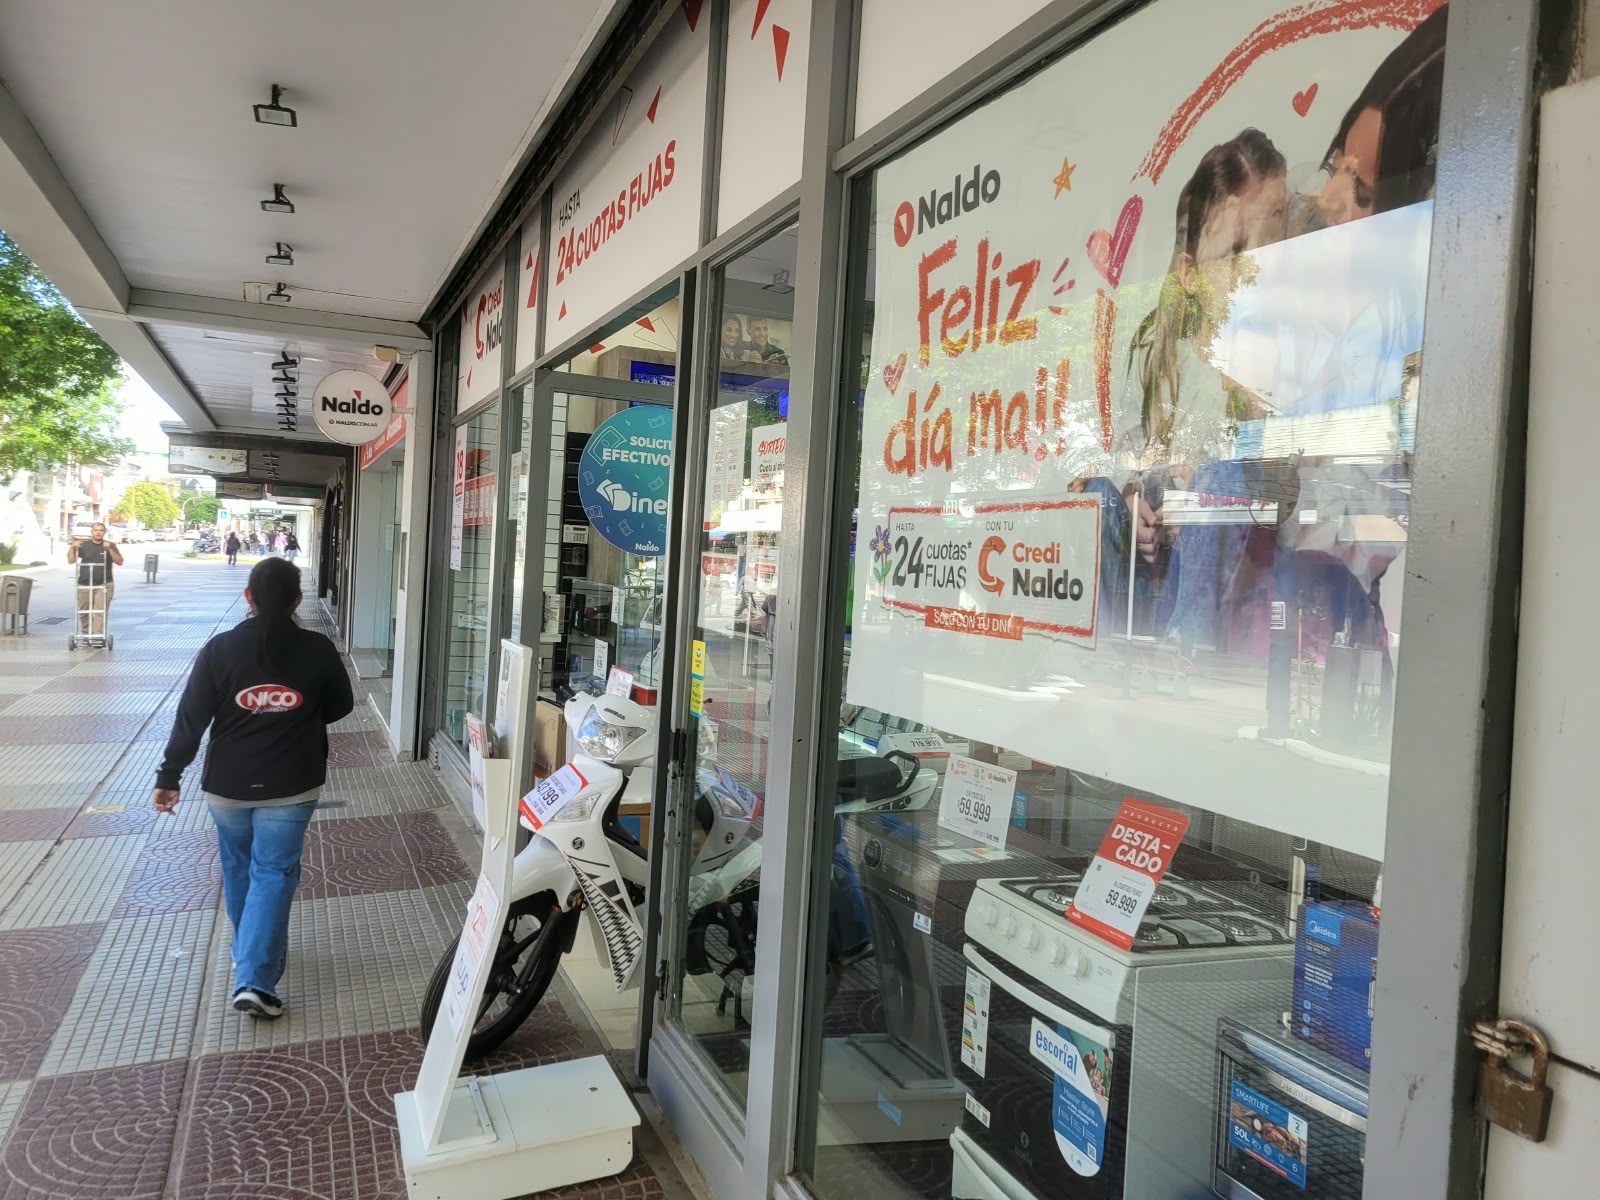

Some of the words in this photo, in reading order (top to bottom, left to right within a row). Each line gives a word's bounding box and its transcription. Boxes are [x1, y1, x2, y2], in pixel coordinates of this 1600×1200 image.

[558, 188, 581, 231] HASTA
[918, 164, 1000, 235] Naldo
[556, 226, 575, 286] 24
[576, 189, 626, 267] CUOTAS
[628, 139, 676, 221] FIJAS
[917, 232, 1041, 367] Feliz
[321, 396, 384, 416] Naldo
[884, 381, 953, 477] día
[602, 447, 671, 467] EFECTIVO
[896, 523, 915, 532] HASTA
[985, 520, 1001, 531] CON
[1003, 520, 1014, 531] TU
[635, 542, 660, 552] Naldo
[1012, 542, 1060, 564] Credi
[892, 535, 924, 588] 24
[924, 564, 967, 589] FIJAS
[1012, 568, 1083, 601] Naldo
[956, 614, 975, 629] CON
[977, 616, 990, 630] TU
[247, 691, 298, 707] NICO
[1115, 845, 1162, 873] CADO
[1105, 889, 1138, 914] 59.999
[1308, 920, 1337, 940] Midea
[1035, 1030, 1078, 1075] escorial
[1235, 1088, 1270, 1114] SMARTLIFE
[1233, 1125, 1250, 1142] 50L
[1295, 1122, 1301, 1131] 2
[1292, 1163, 1298, 1173] 6
